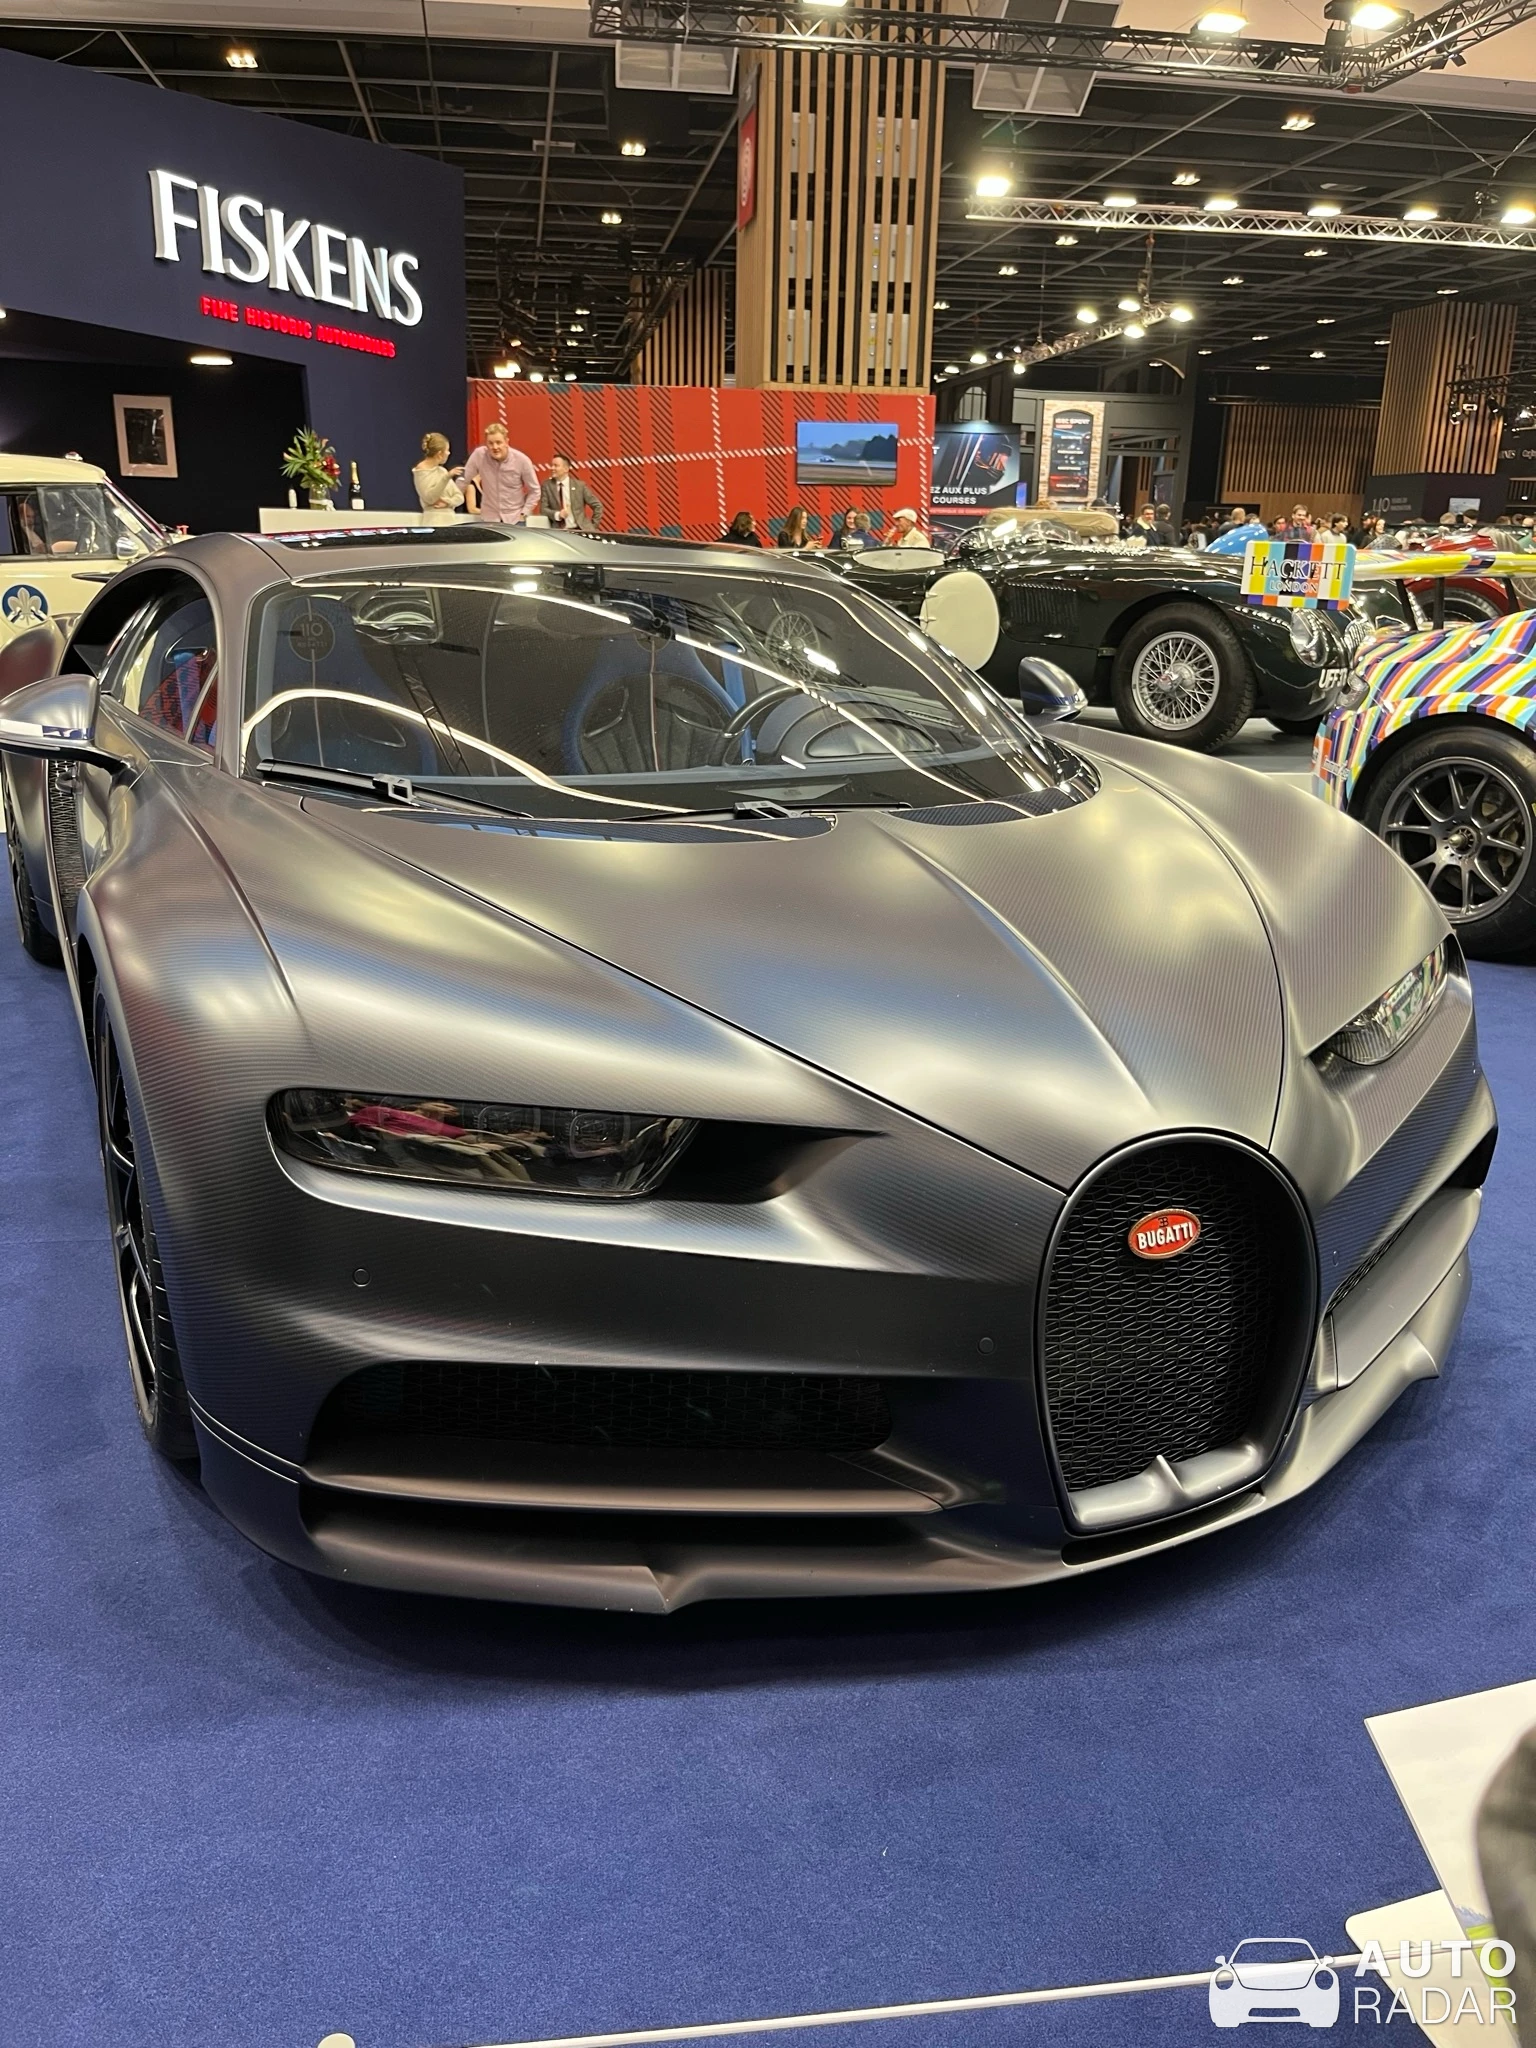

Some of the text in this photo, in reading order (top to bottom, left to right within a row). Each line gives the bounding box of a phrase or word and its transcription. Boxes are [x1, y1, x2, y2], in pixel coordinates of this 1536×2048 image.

[148, 169, 424, 327] FISKENS
[201, 297, 239, 323] FINE
[245, 307, 313, 339] HISTORIC
[932, 496, 977, 504] COURSES
[963, 487, 987, 495] PLUS
[1249, 556, 1347, 580] HACKETT
[1269, 580, 1319, 593] LONDON
[1137, 1221, 1194, 1250] BUGATTI
